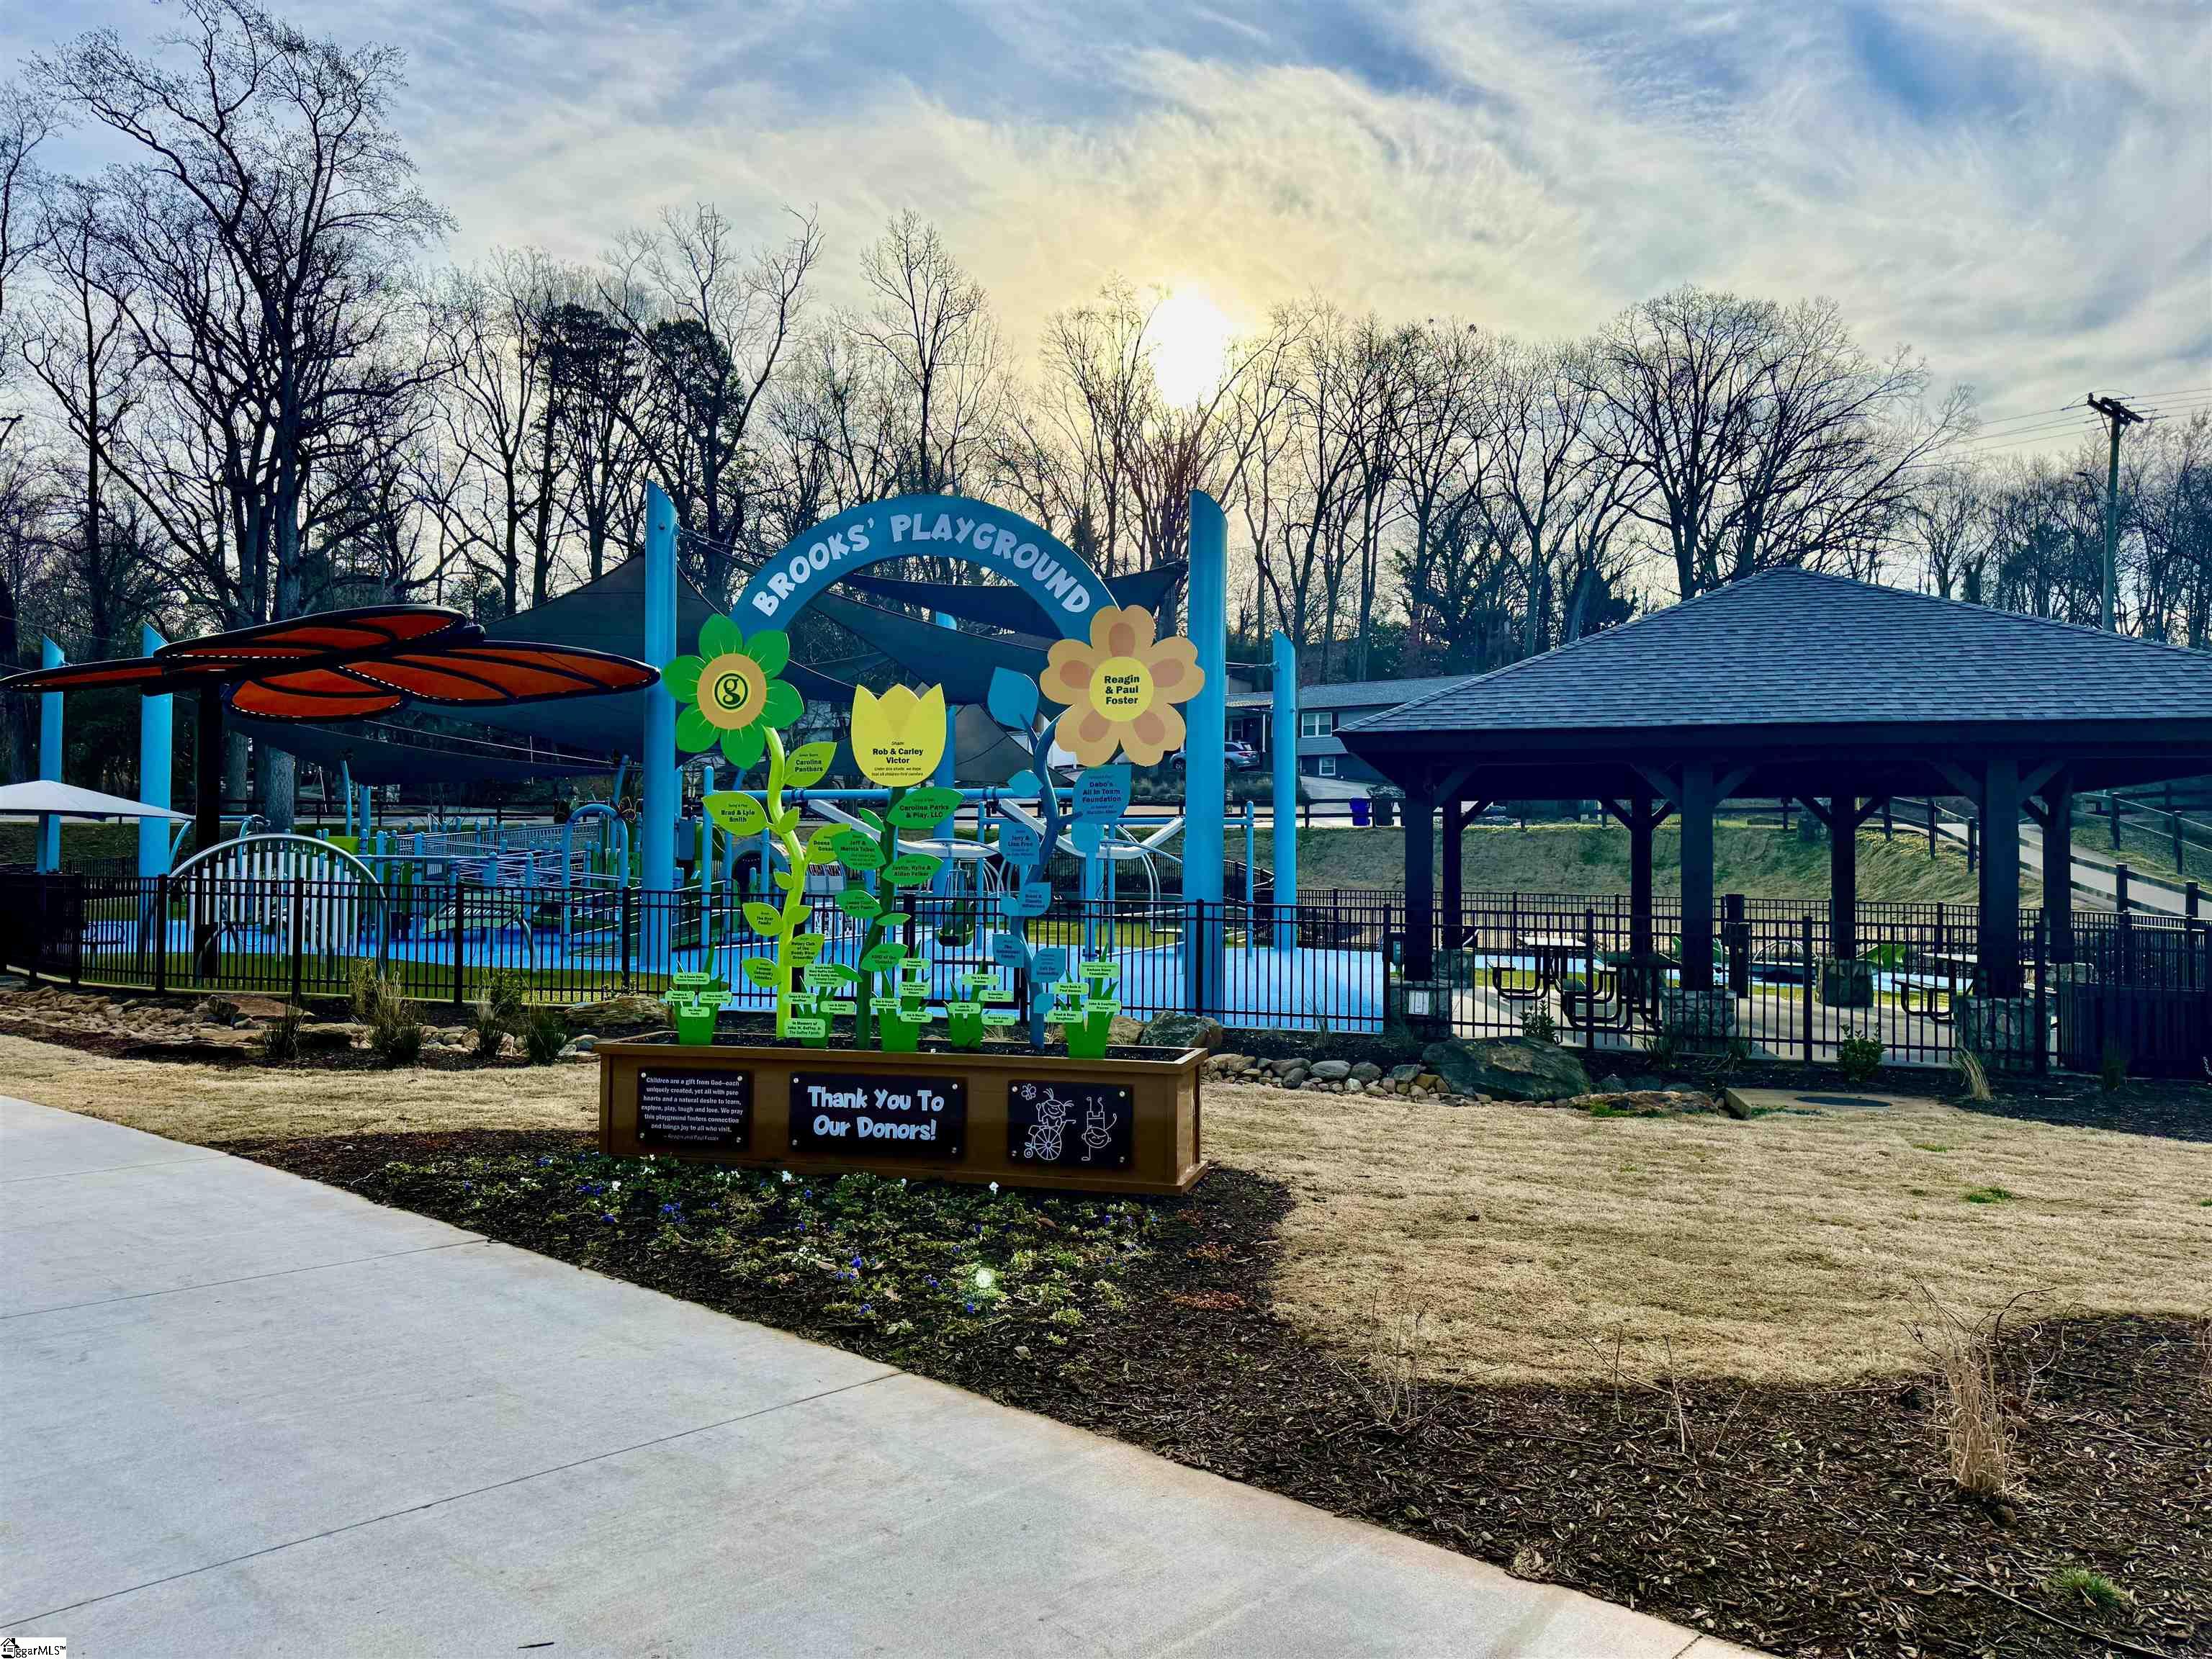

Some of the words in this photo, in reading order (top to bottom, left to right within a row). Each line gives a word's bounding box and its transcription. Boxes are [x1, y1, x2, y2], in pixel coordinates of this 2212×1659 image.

[890, 513, 1090, 612] PLAYGROUND
[723, 678, 741, 705] g
[1104, 675, 1140, 685] Reagin
[1105, 685, 1113, 694] &
[1116, 685, 1138, 694] Paul
[807, 1086, 868, 1108] Thank
[874, 1089, 911, 1110] You
[917, 1089, 945, 1112] To
[813, 1115, 851, 1136] Our
[856, 1117, 937, 1141] Donors!
